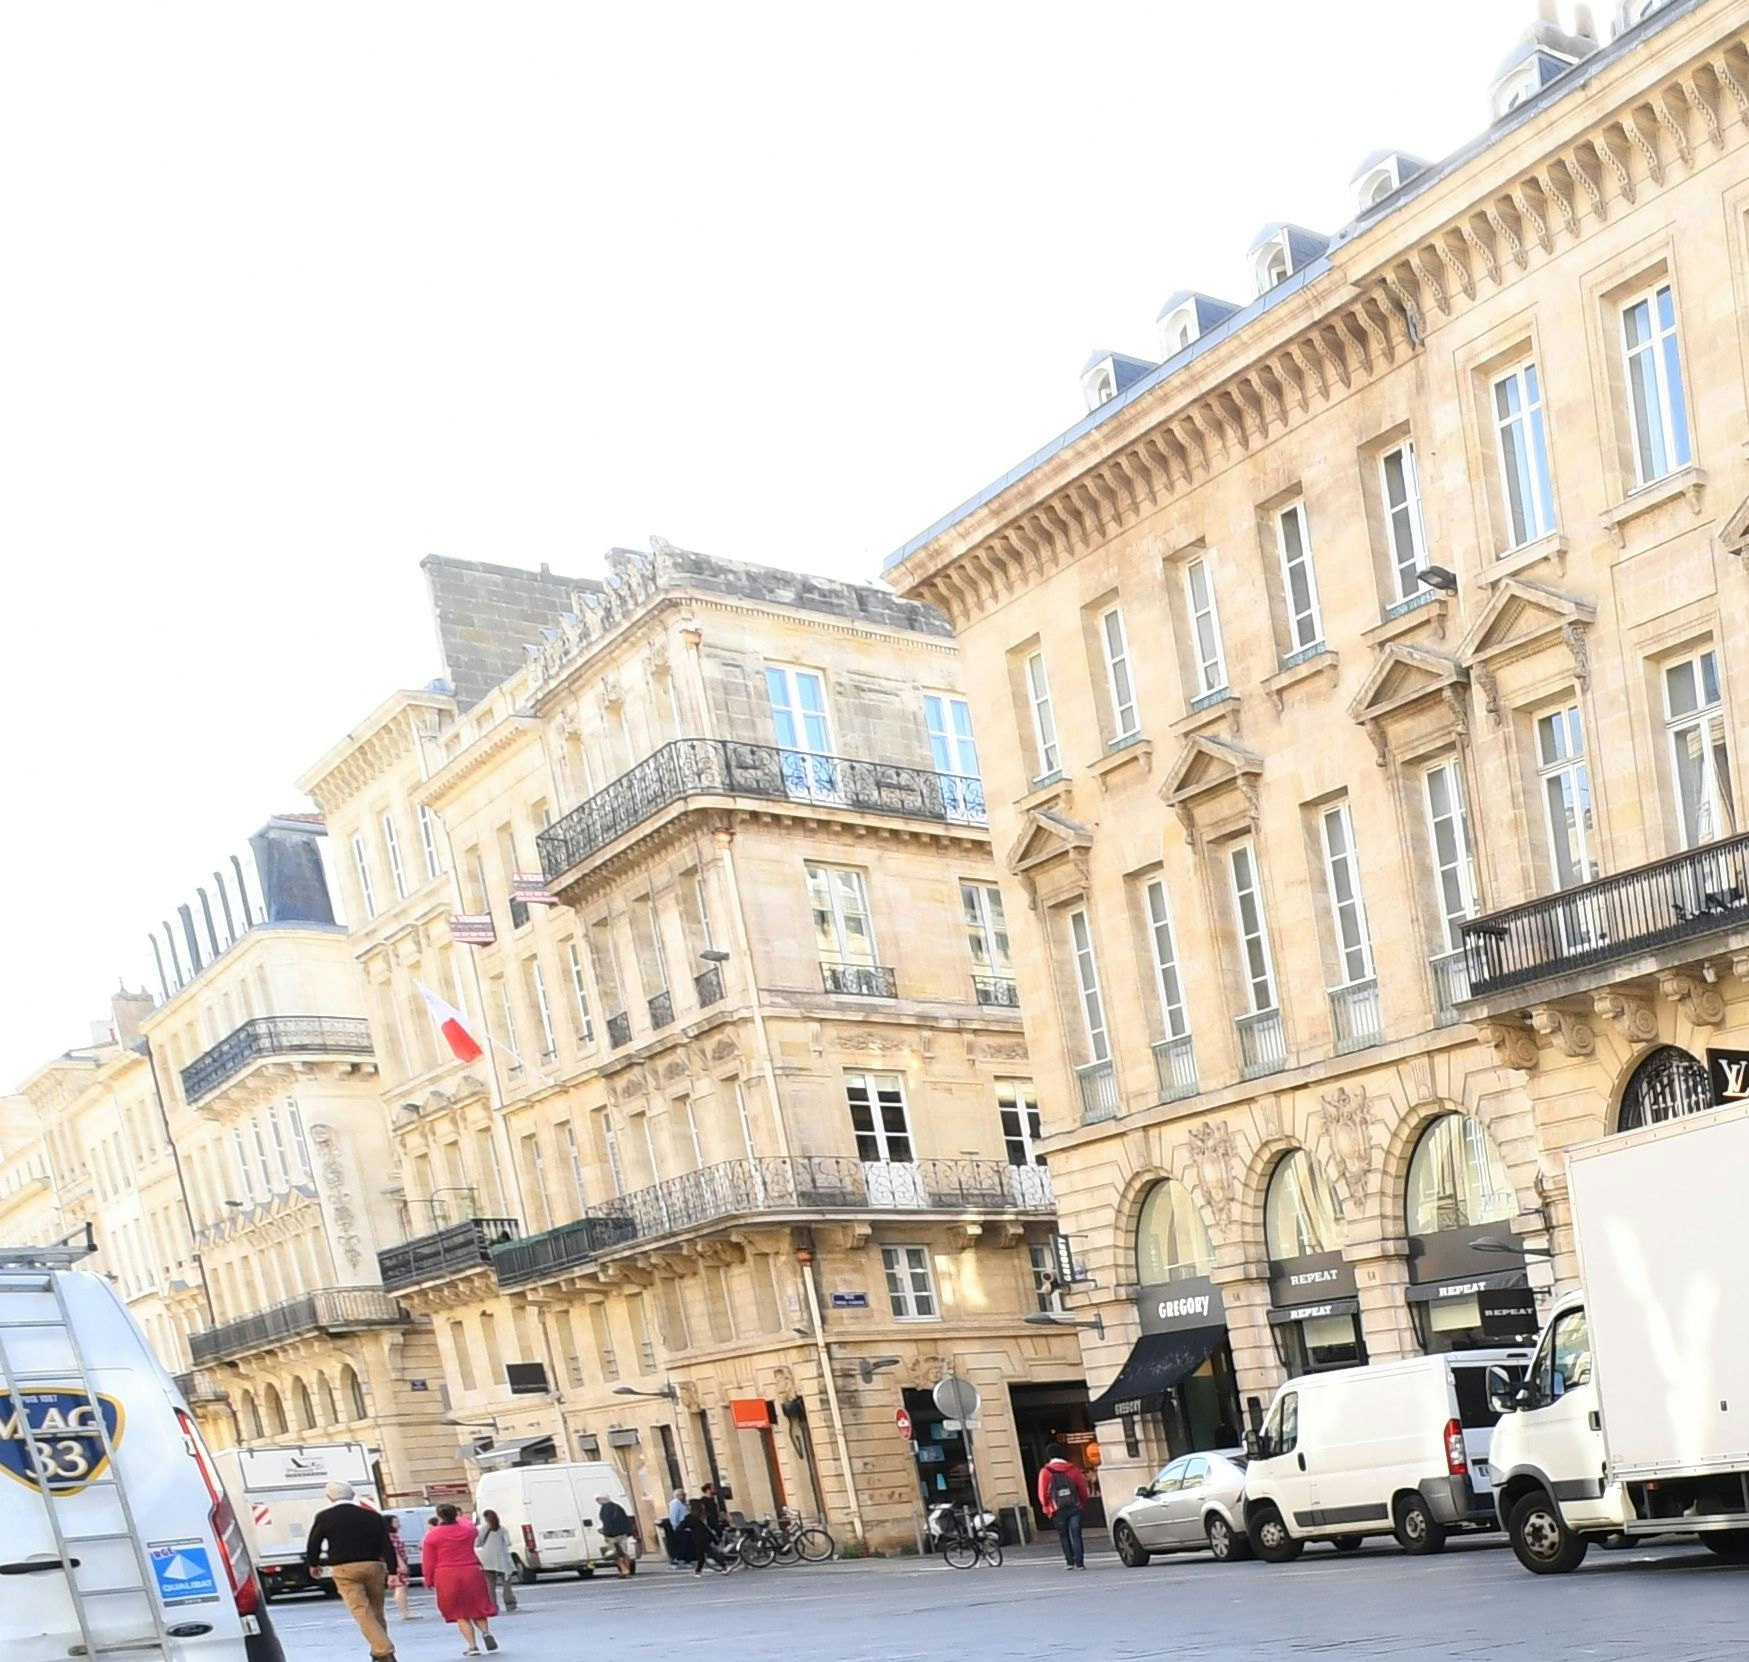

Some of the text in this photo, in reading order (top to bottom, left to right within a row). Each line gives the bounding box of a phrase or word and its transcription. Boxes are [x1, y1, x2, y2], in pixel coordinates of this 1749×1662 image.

[1057, 1237, 1072, 1282] GREGORY
[1290, 1269, 1338, 1286] REPEAT
[1438, 1281, 1487, 1297] REPEAT
[1158, 1295, 1209, 1319] GREGORY
[1290, 1305, 1332, 1319] REPEAT
[1484, 1308, 1534, 1317] REPEAT
[25, 1440, 88, 1478] 33
[162, 1579, 212, 1592] QUALIBAT
